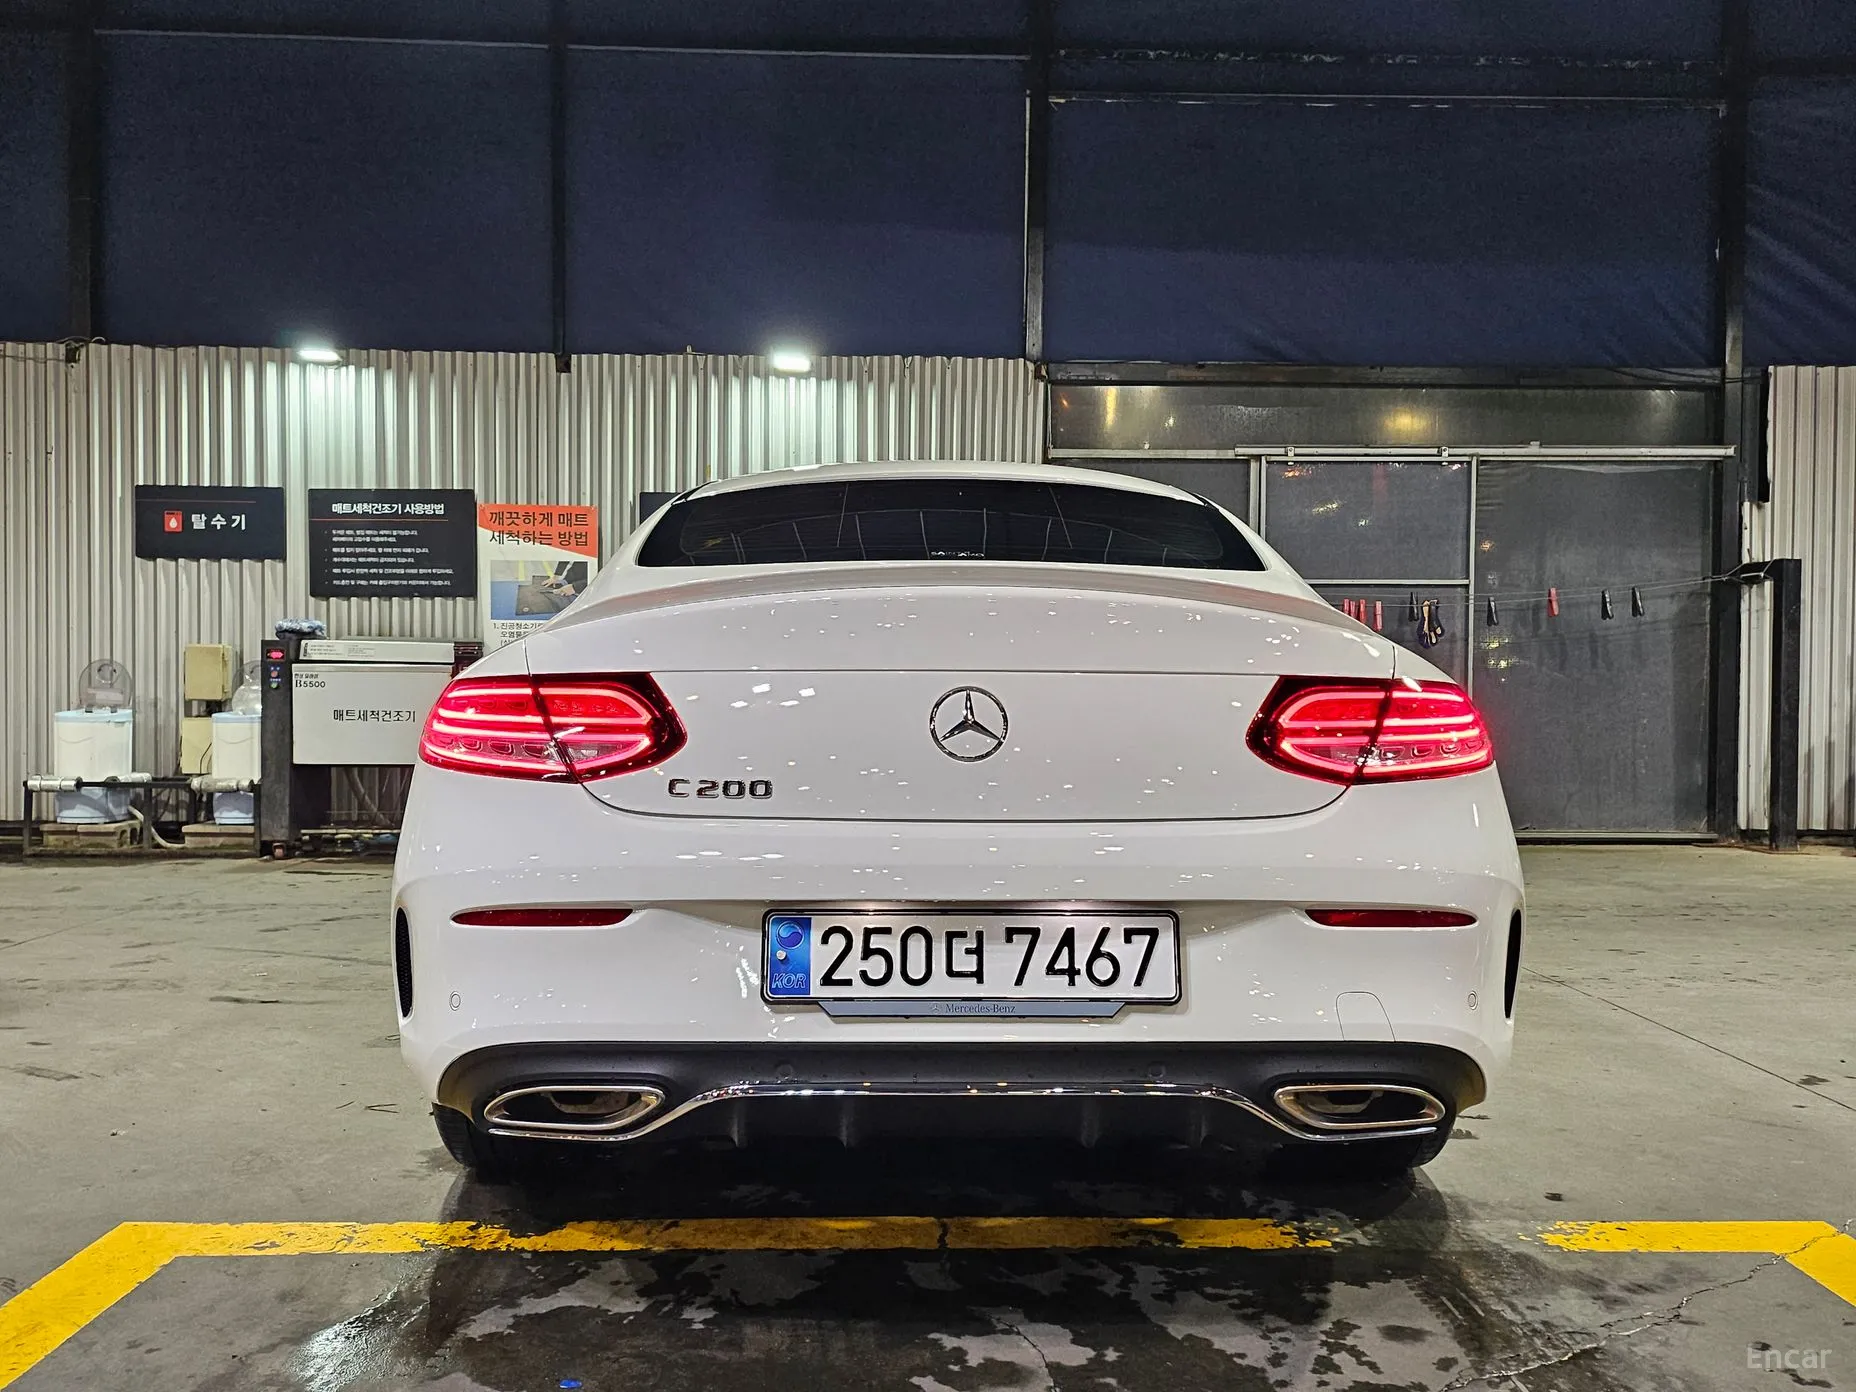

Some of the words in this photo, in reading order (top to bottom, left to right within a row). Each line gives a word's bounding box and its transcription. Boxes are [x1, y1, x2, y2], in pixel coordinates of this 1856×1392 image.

[332, 503, 401, 514] 매트세척건조기
[404, 504, 444, 514] 사용방법
[489, 511, 553, 527] 깨끗하게
[558, 512, 589, 527] 매트
[489, 530, 553, 546] 세척하는
[558, 531, 588, 546] 방법
[295, 679, 326, 688] B5500
[333, 709, 416, 723] 매트세척건조기
[668, 779, 690, 798] C
[696, 779, 773, 799] 200
[820, 925, 984, 987] 250더
[1005, 926, 1160, 987] 7467
[772, 973, 806, 988] KOR
[945, 1003, 1016, 1013] Mercedes-Benz
